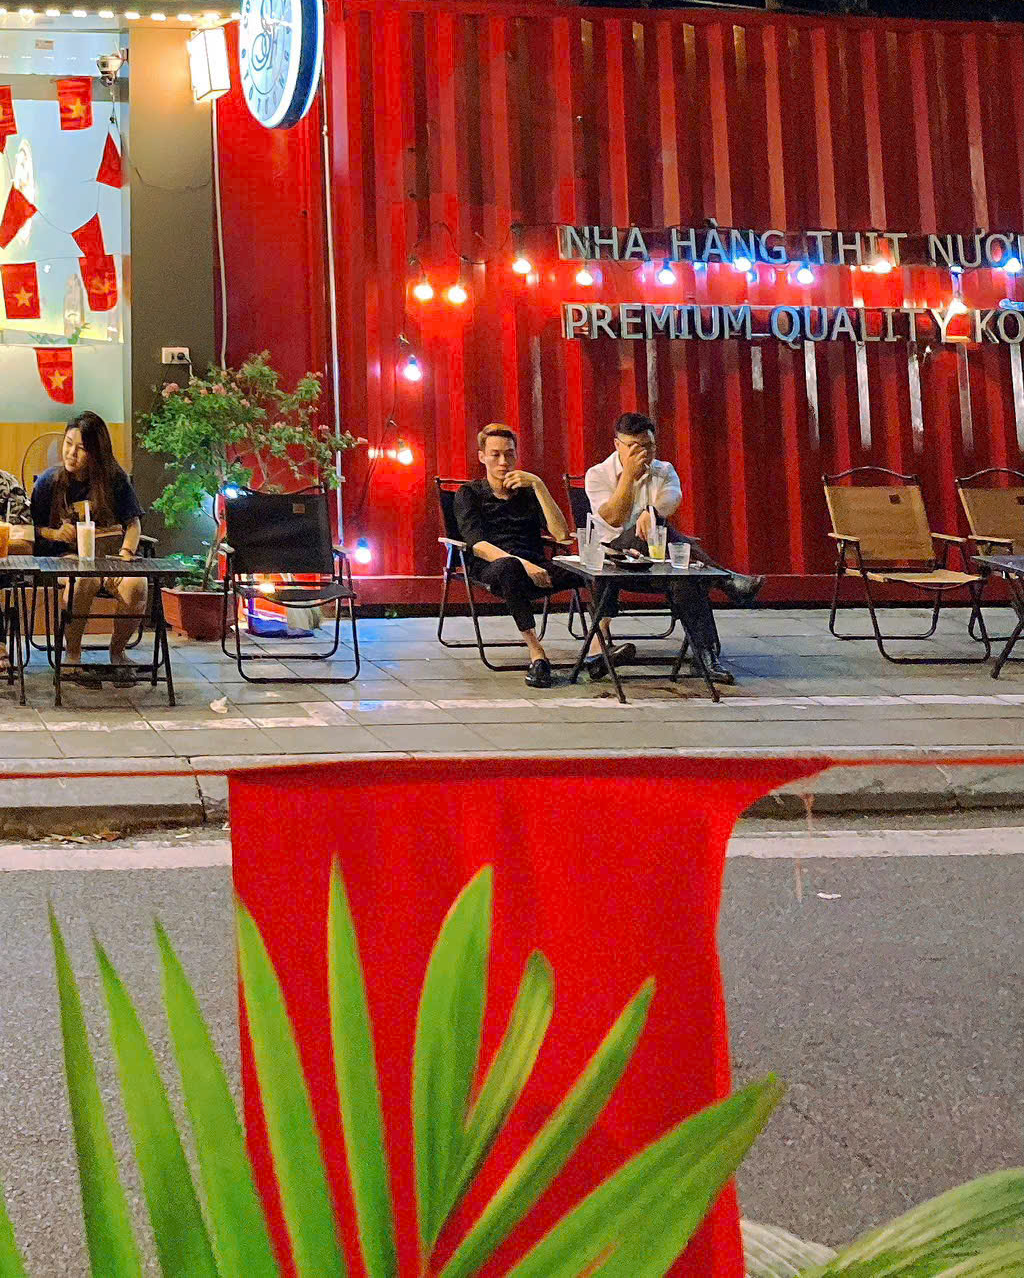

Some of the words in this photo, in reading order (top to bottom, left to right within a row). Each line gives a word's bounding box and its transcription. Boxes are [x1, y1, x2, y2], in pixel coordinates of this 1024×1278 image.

[670, 217, 789, 264] HÀNG
[564, 302, 752, 341] PREMIUM
[770, 304, 968, 349] QUALITY
